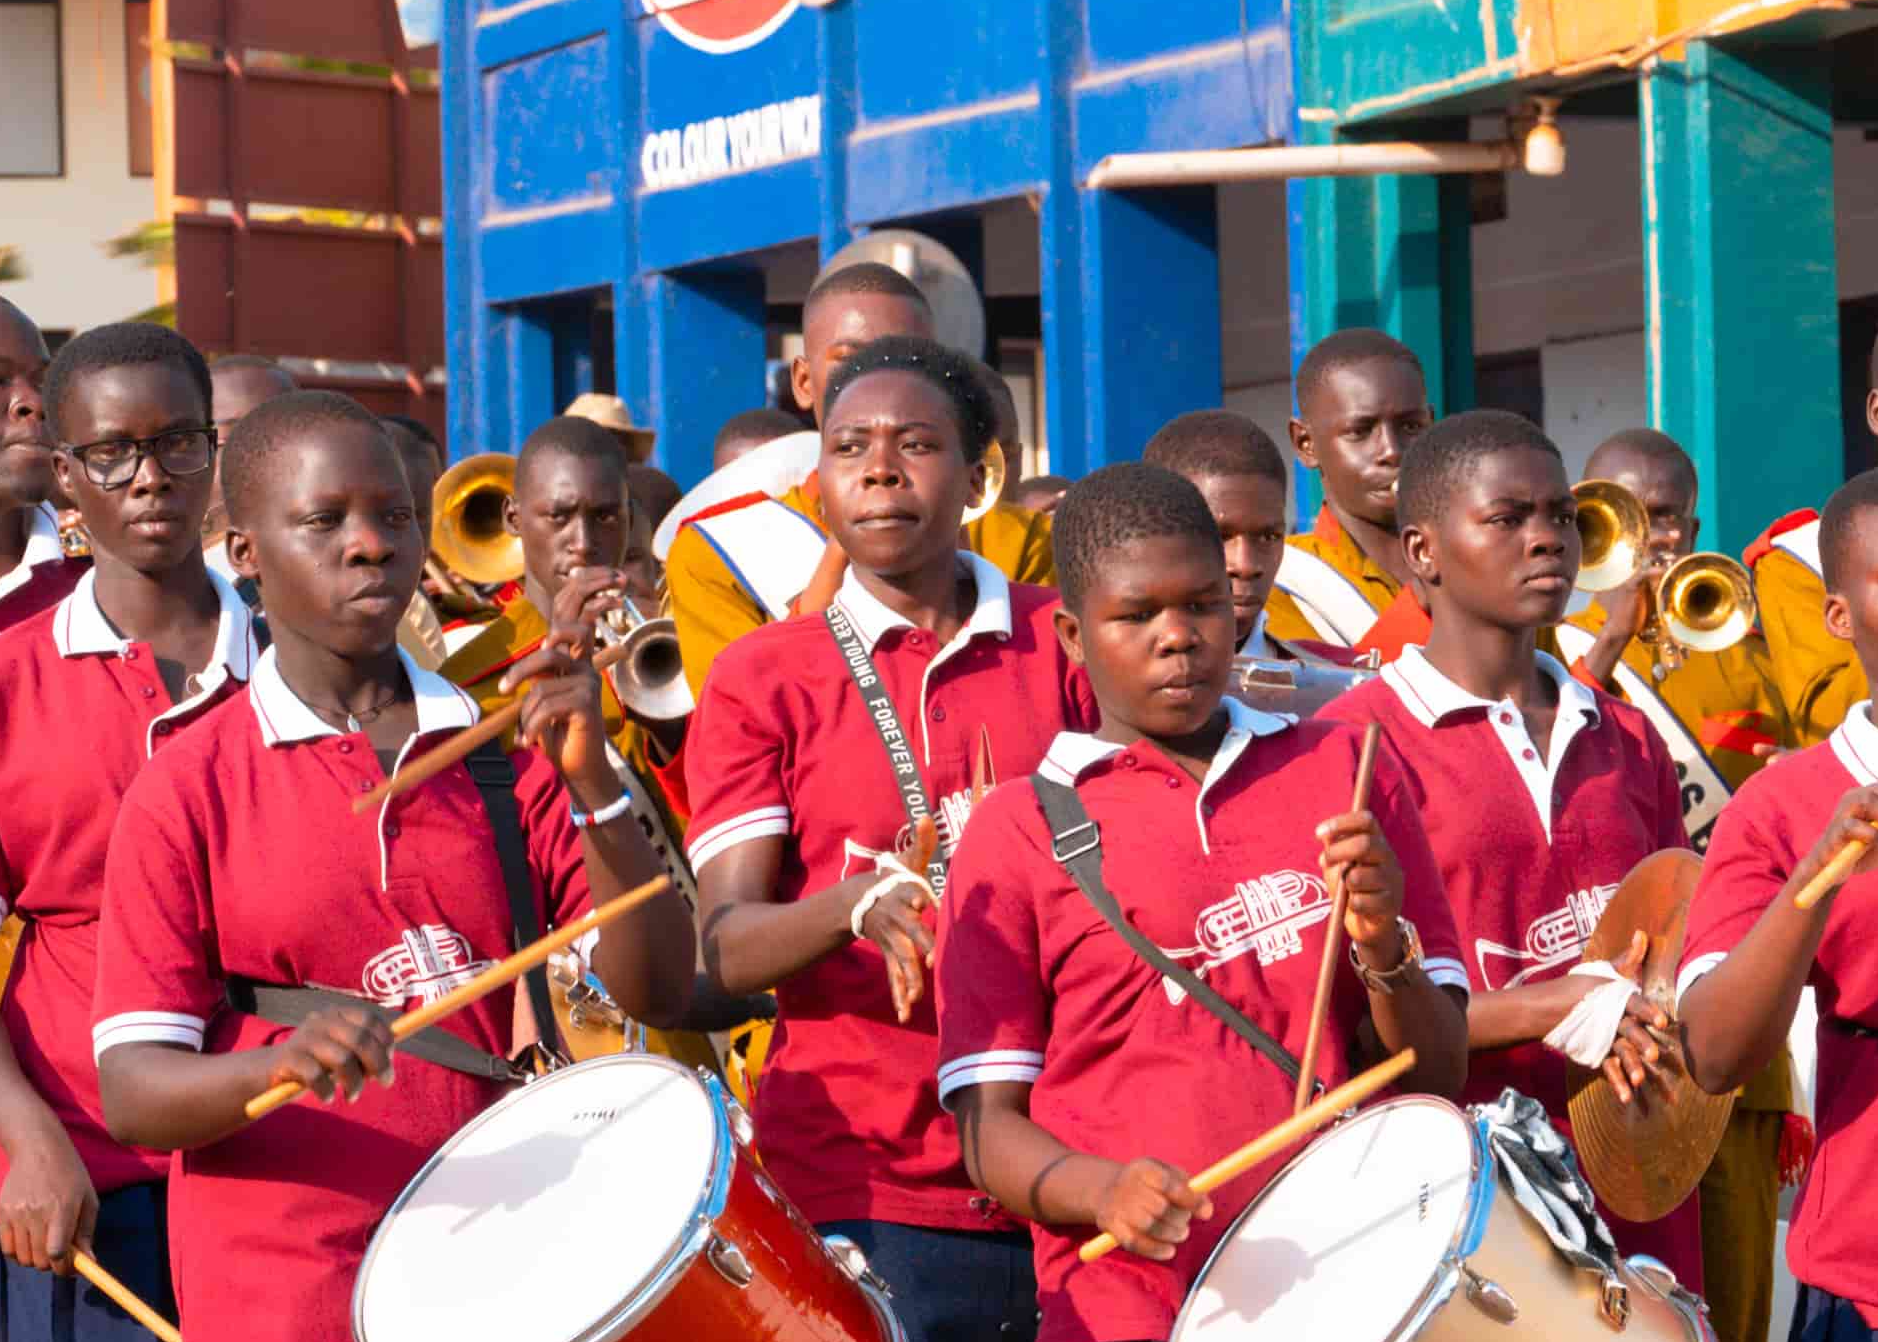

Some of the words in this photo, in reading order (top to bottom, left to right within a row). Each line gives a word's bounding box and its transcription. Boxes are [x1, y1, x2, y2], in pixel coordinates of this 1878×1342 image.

[842, 638, 877, 689] YOUNG
[869, 696, 915, 775] FOREVER
[903, 780, 926, 825] YOU
